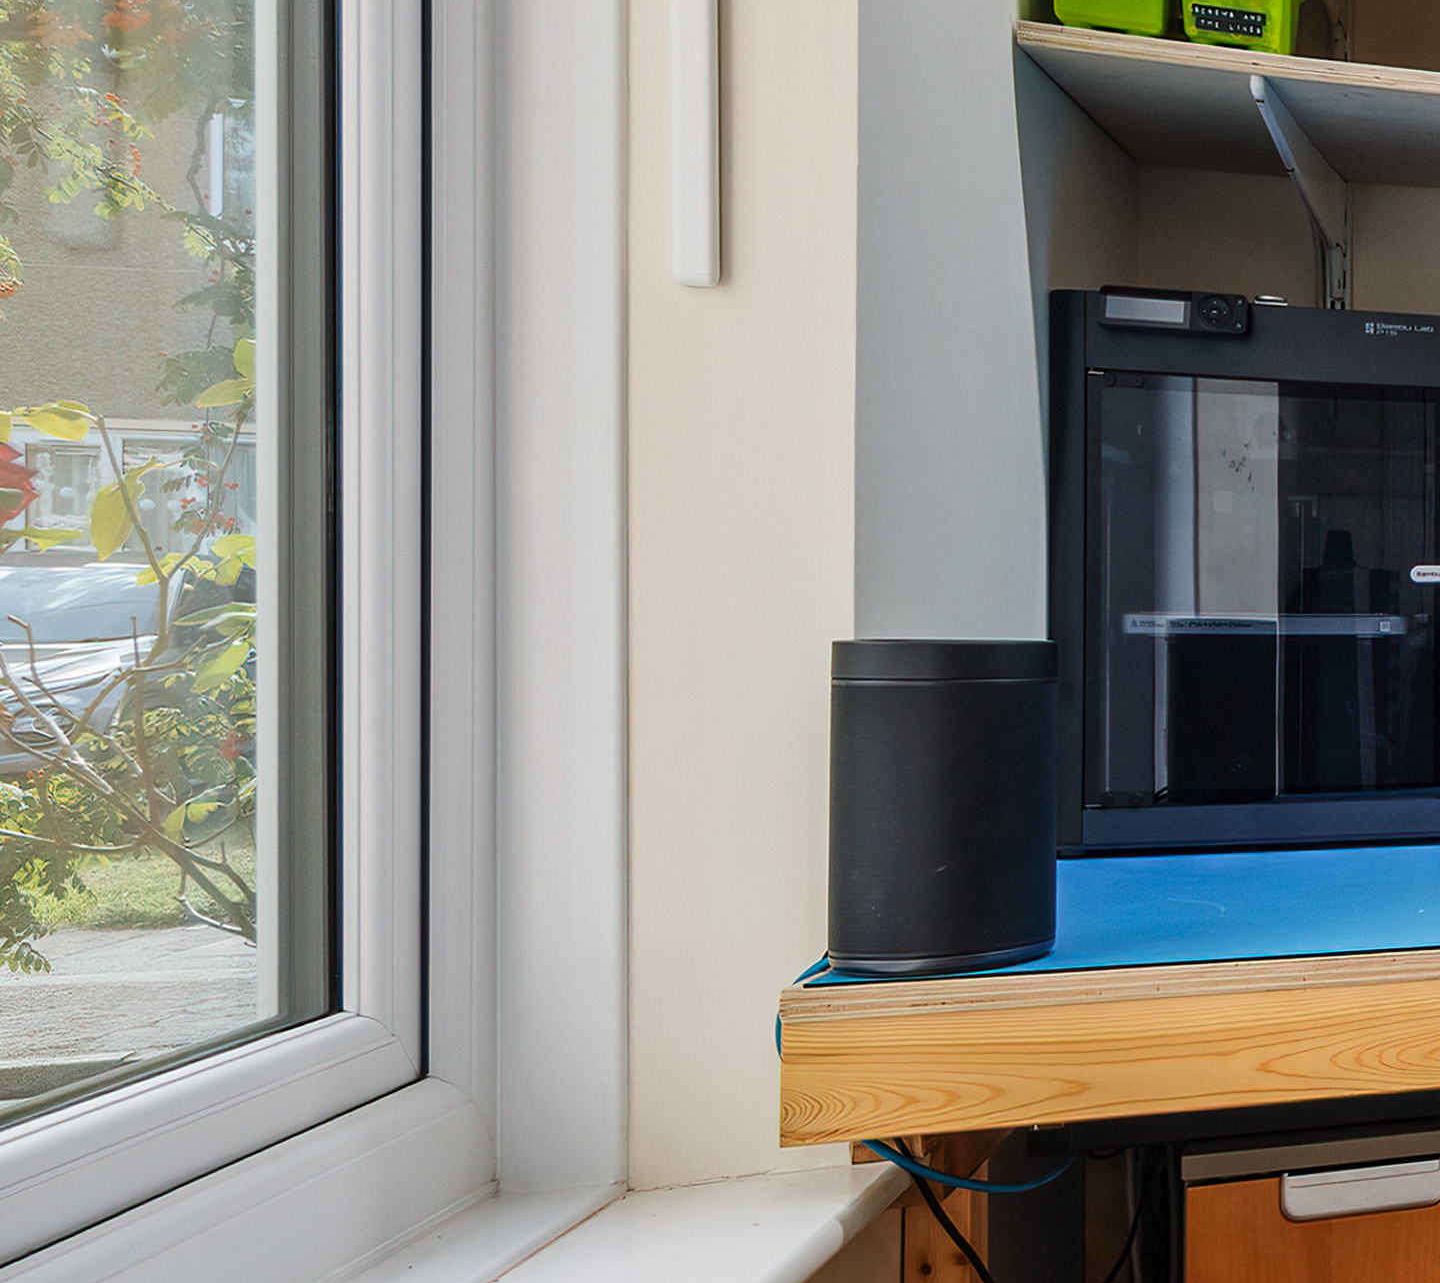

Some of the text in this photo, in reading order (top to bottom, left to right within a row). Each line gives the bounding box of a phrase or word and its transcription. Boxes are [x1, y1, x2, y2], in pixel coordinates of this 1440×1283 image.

[1243, 13, 1263, 23] AND
[1200, 19, 1221, 30] THE
[1414, 325, 1434, 333] Lab
